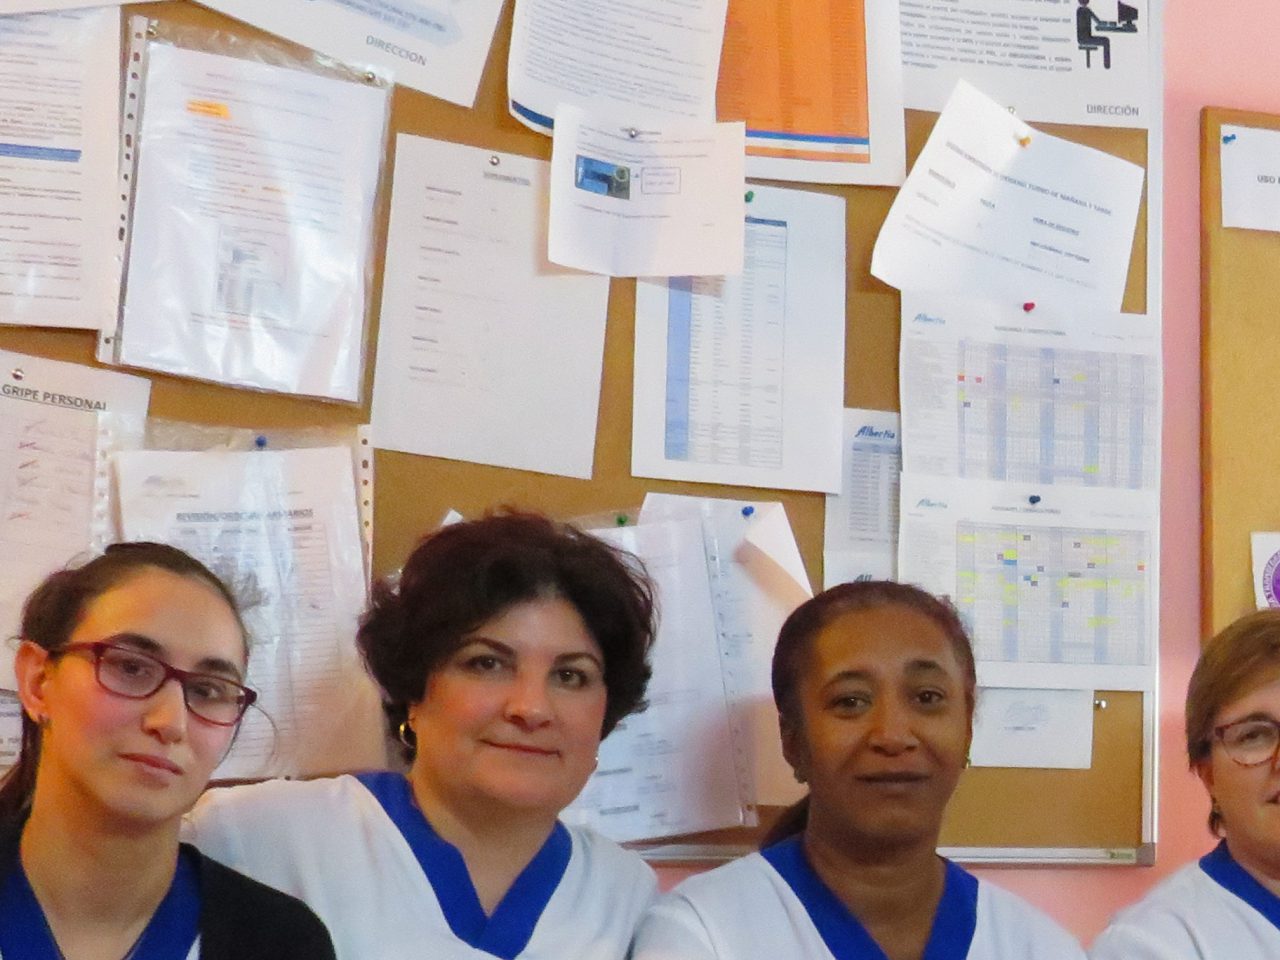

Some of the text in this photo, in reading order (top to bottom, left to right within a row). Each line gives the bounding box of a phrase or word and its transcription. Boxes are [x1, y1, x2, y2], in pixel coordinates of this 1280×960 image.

[1257, 174, 1276, 184] USO
[1, 383, 40, 401] GRIPE
[854, 425, 896, 439] Albertia
